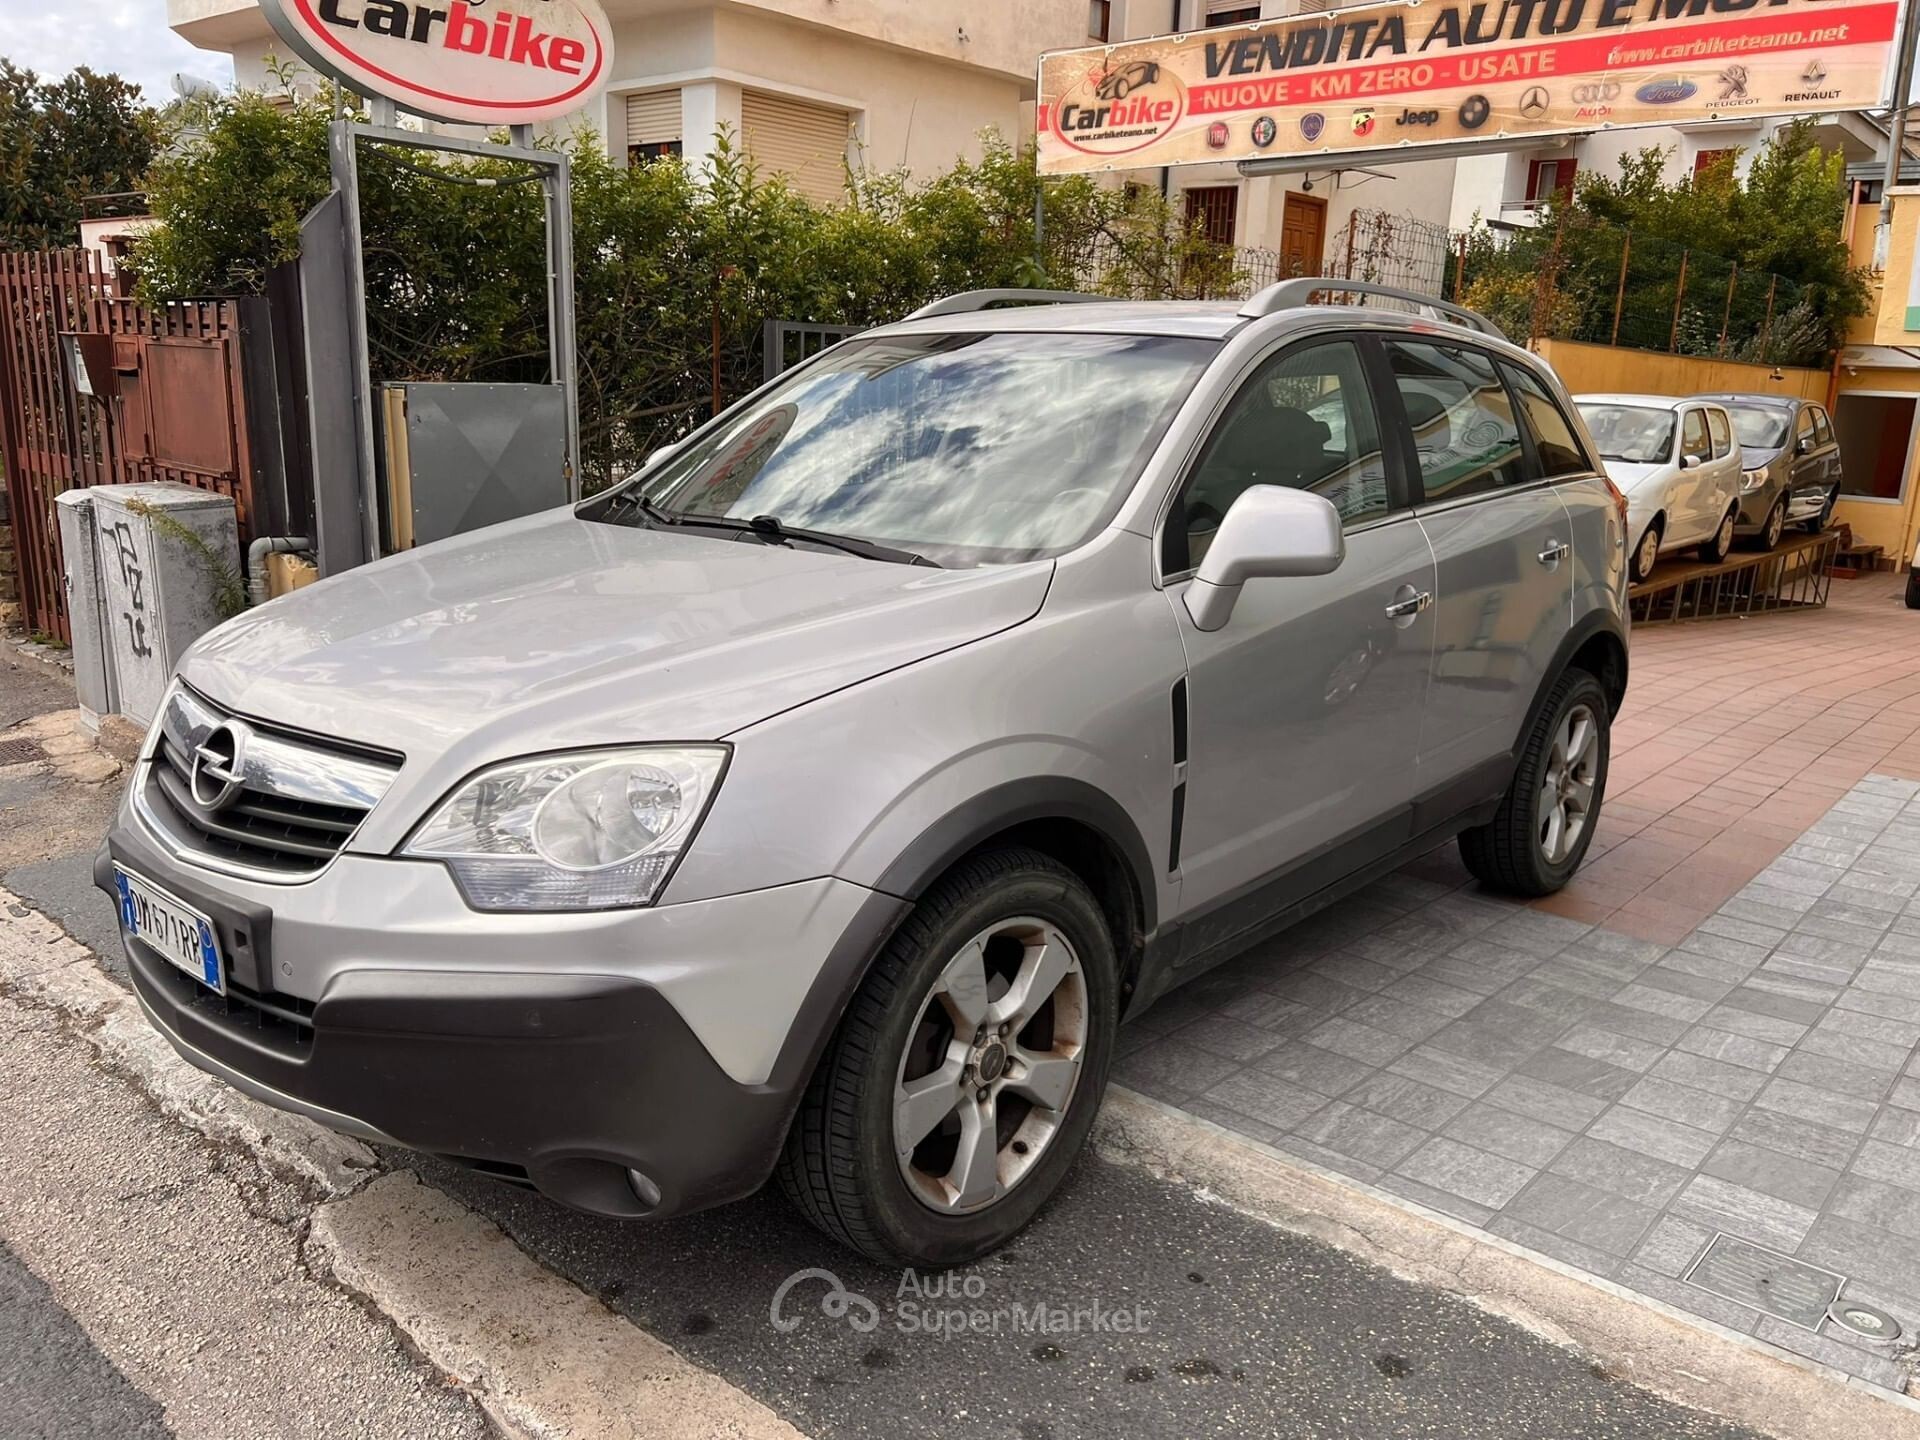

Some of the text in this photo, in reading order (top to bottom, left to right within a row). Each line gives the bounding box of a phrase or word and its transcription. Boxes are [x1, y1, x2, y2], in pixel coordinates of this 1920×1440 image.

[1205, 17, 1406, 78] VENDITA
[1418, 0, 1587, 52] AUTO
[1597, 0, 1636, 28] E
[1607, 23, 1849, 65] www.carbiketeano.net
[1203, 82, 1289, 109] NUOVE
[1310, 75, 1351, 98] KM
[1358, 64, 1434, 93] ZERO
[1459, 49, 1557, 81] USATE
[1705, 98, 1760, 109] PEUGEOT
[1784, 90, 1841, 102] RENAULT
[1061, 97, 1174, 131] Carbike
[1396, 109, 1439, 127] Jeep
[1575, 106, 1612, 118] Audi
[1074, 127, 1158, 142] www.carbiketeano.net
